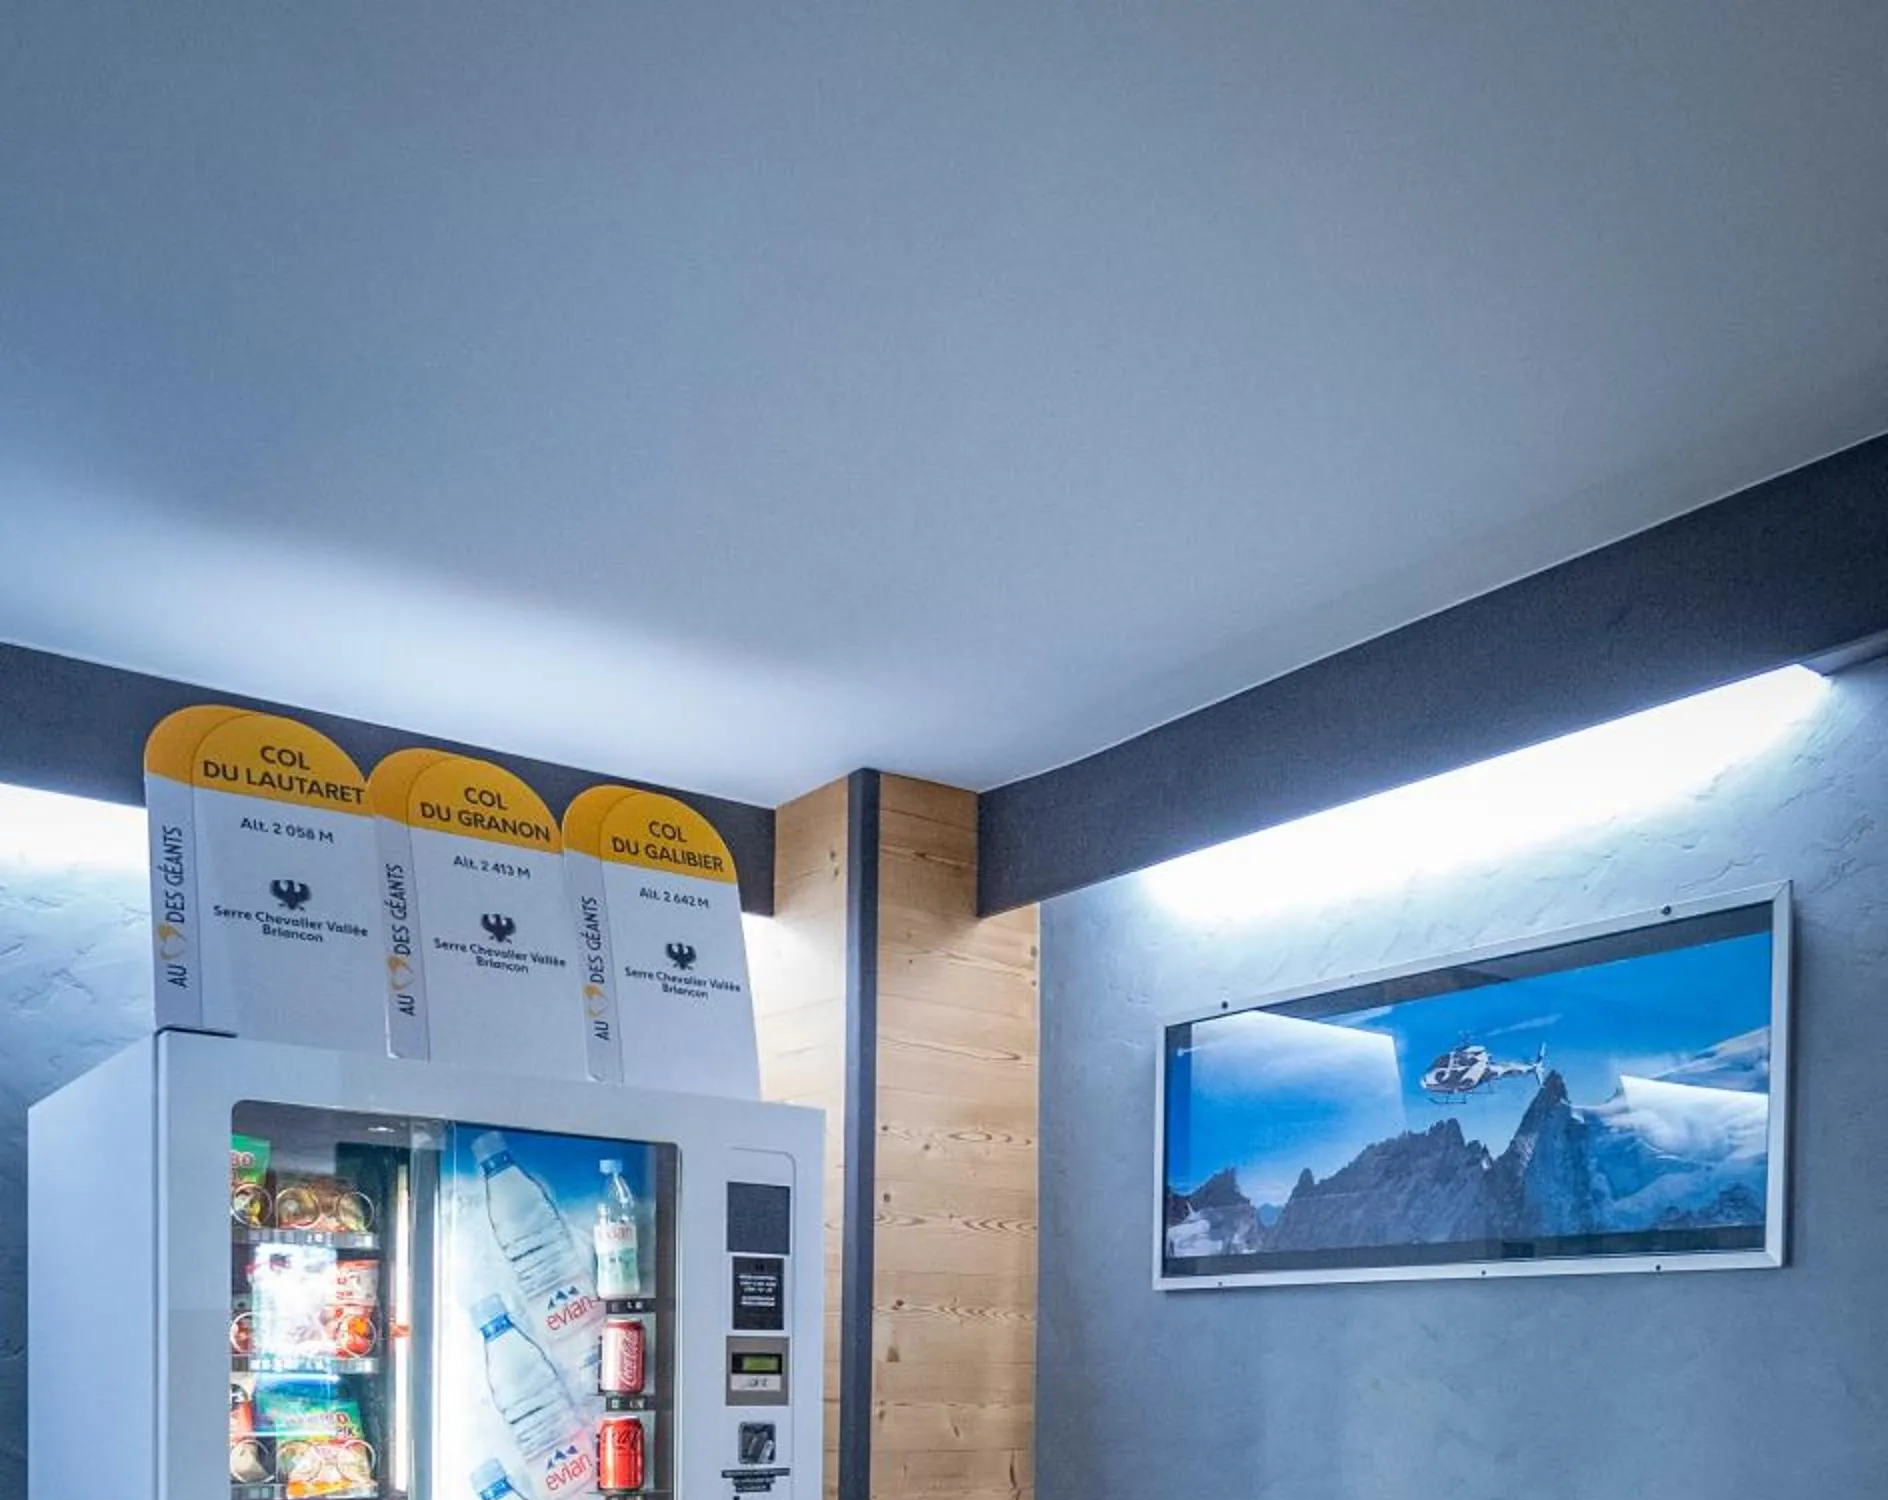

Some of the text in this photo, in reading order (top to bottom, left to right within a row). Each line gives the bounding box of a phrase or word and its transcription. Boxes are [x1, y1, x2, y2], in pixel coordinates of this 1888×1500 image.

[260, 745, 311, 770] COL
[203, 760, 364, 805] DU LAUTARET
[464, 787, 508, 810] COL
[240, 817, 269, 833] Alt.
[272, 823, 281, 834] 2
[319, 831, 334, 844] M
[420, 802, 551, 842] DU GRANON
[649, 820, 688, 842] COL
[453, 855, 478, 870] Alt.
[517, 867, 531, 879] M
[612, 836, 724, 872] DU GALIBIER
[158, 825, 187, 989] AU DES GÉANTS
[213, 905, 252, 920] Serre
[255, 911, 323, 930] Chevalier
[385, 864, 415, 1016] AU DES GÉANTS
[433, 937, 467, 952] Serre
[469, 943, 528, 960] Chevalier
[579, 896, 610, 1040] AU DES GÉANTS
[625, 966, 654, 980] Serre
[656, 971, 707, 986] Chevalier
[545, 1295, 593, 1331] evian
[545, 1453, 593, 1491] evian
